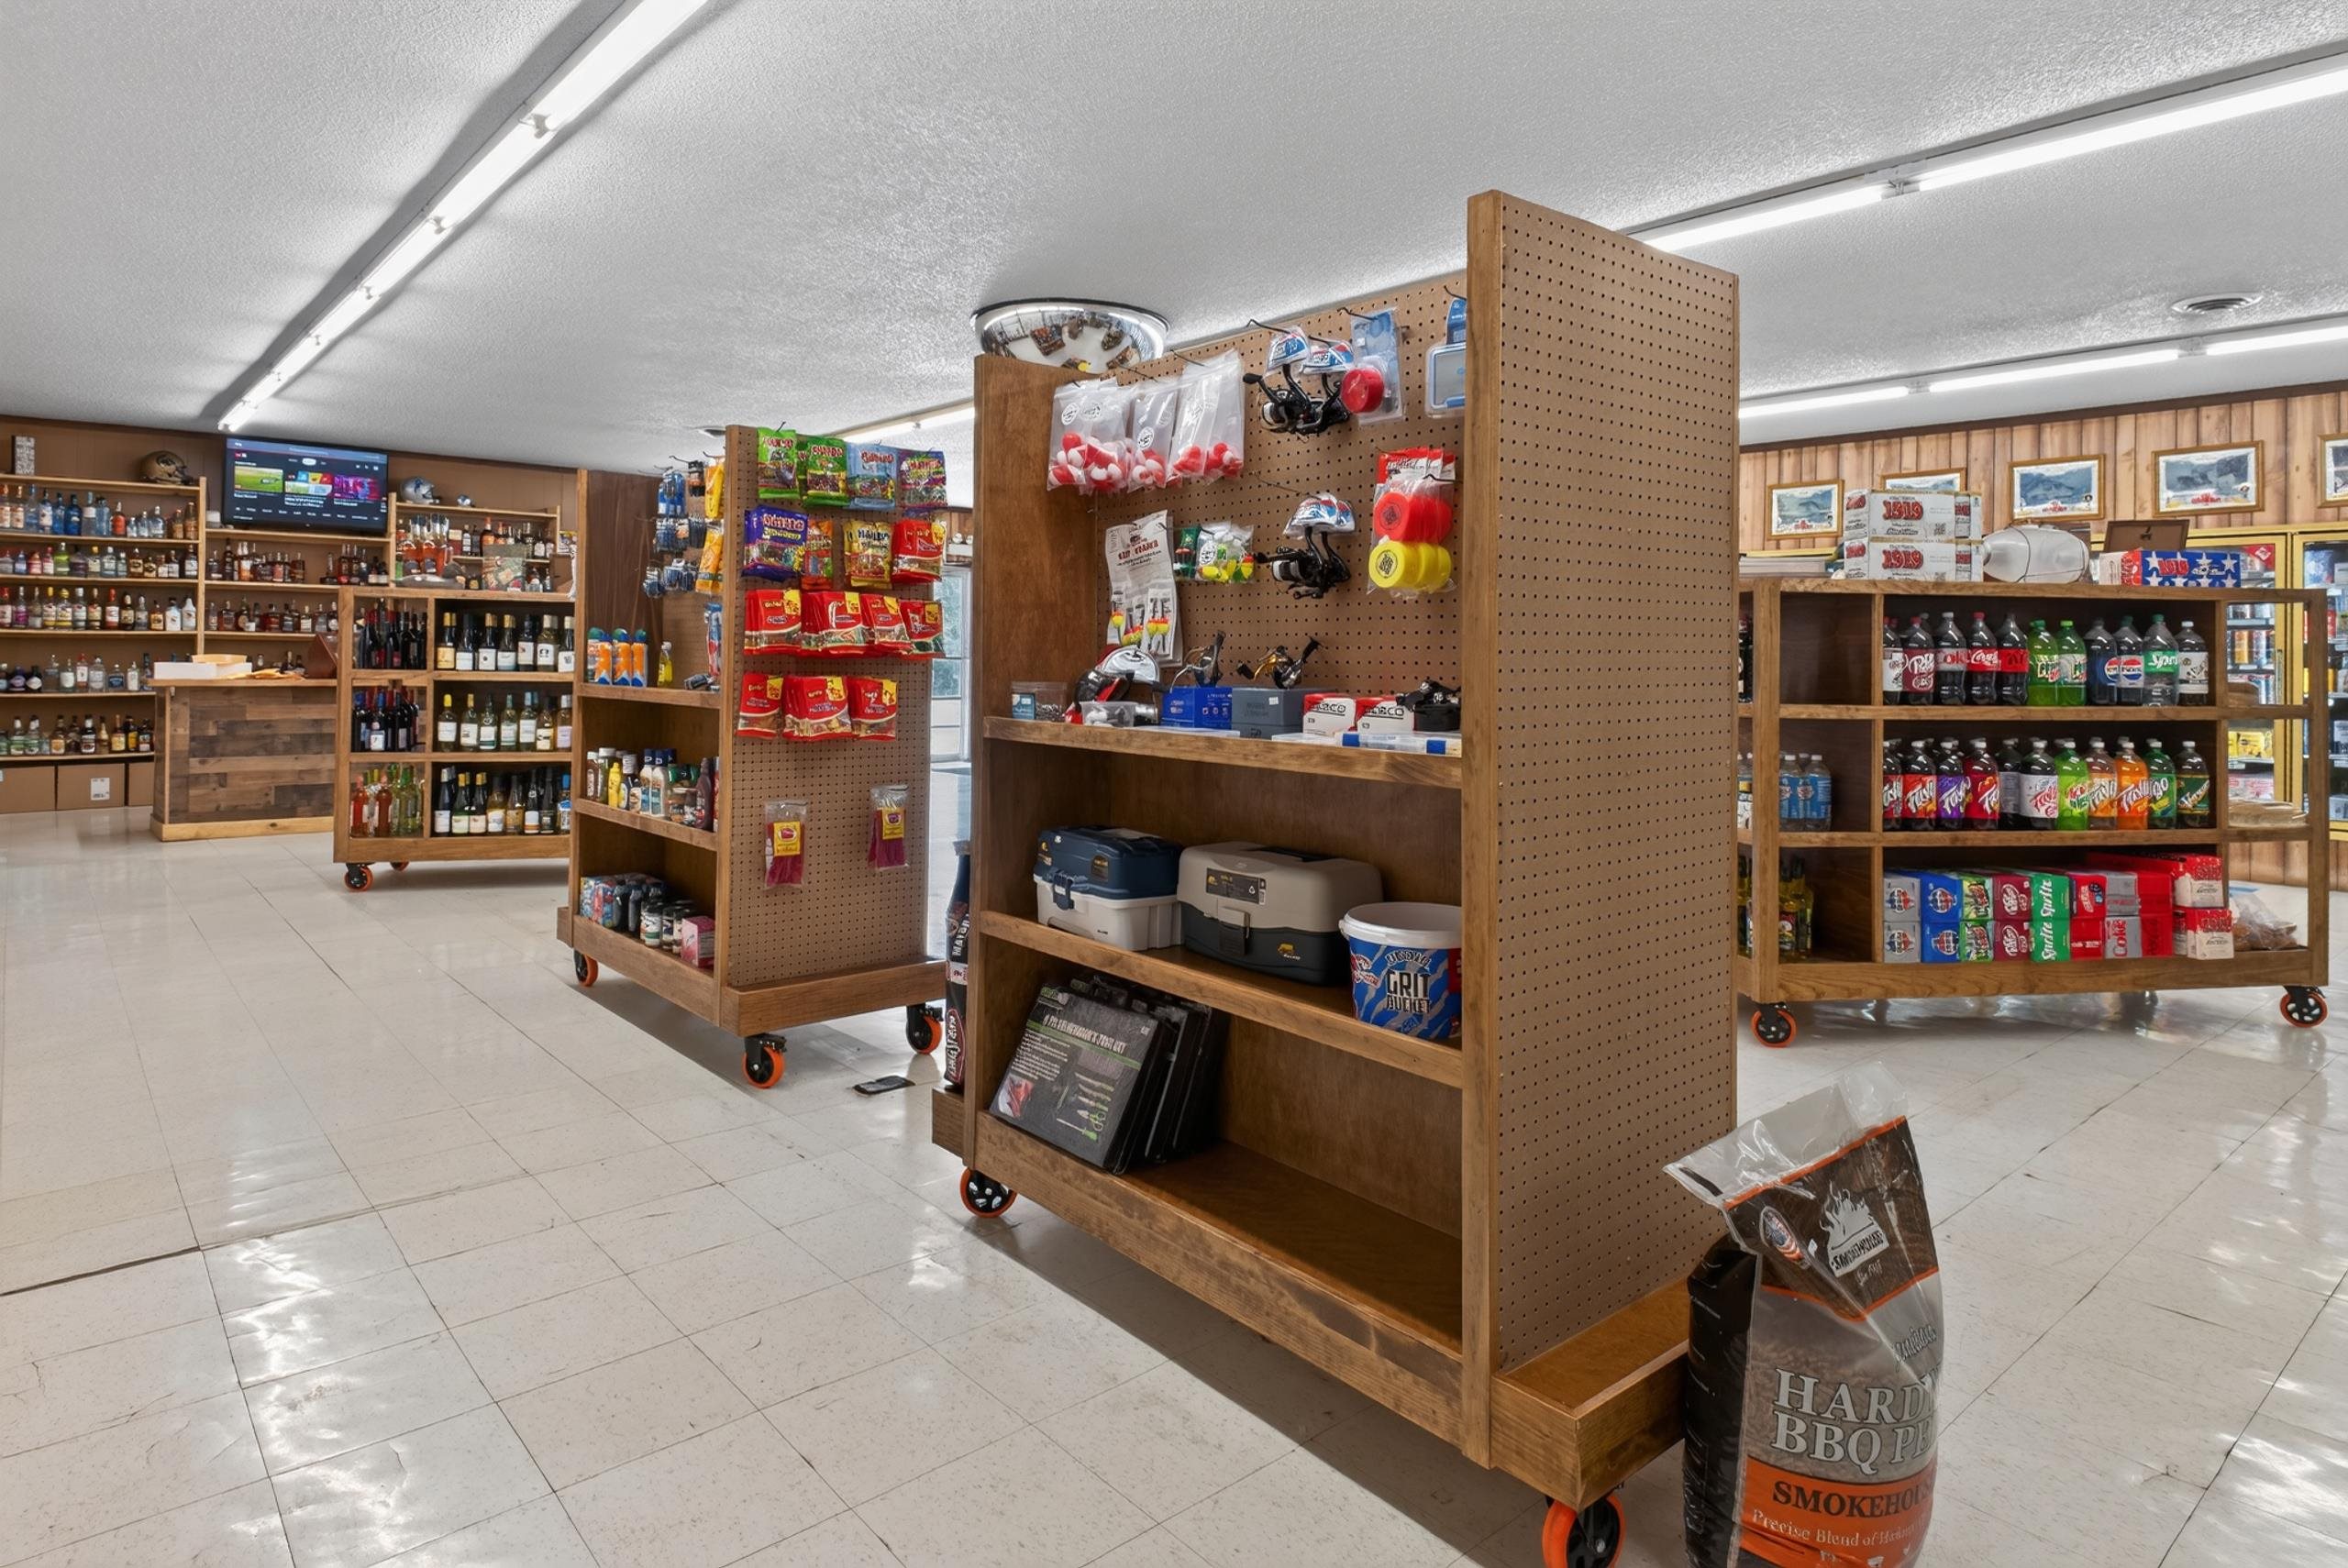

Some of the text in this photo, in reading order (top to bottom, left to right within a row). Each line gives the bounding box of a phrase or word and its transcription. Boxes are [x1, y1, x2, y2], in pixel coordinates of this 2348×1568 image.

[2040, 879, 2055, 918] Sprite
[1386, 970, 1431, 999] GRIT
[1386, 995, 1431, 1013] BUCKET
[1771, 1410, 1882, 1475] BBQ
[1752, 1508, 1811, 1541] Precise
[1816, 1528, 1859, 1547] Blend
[1863, 1531, 1877, 1546] of
